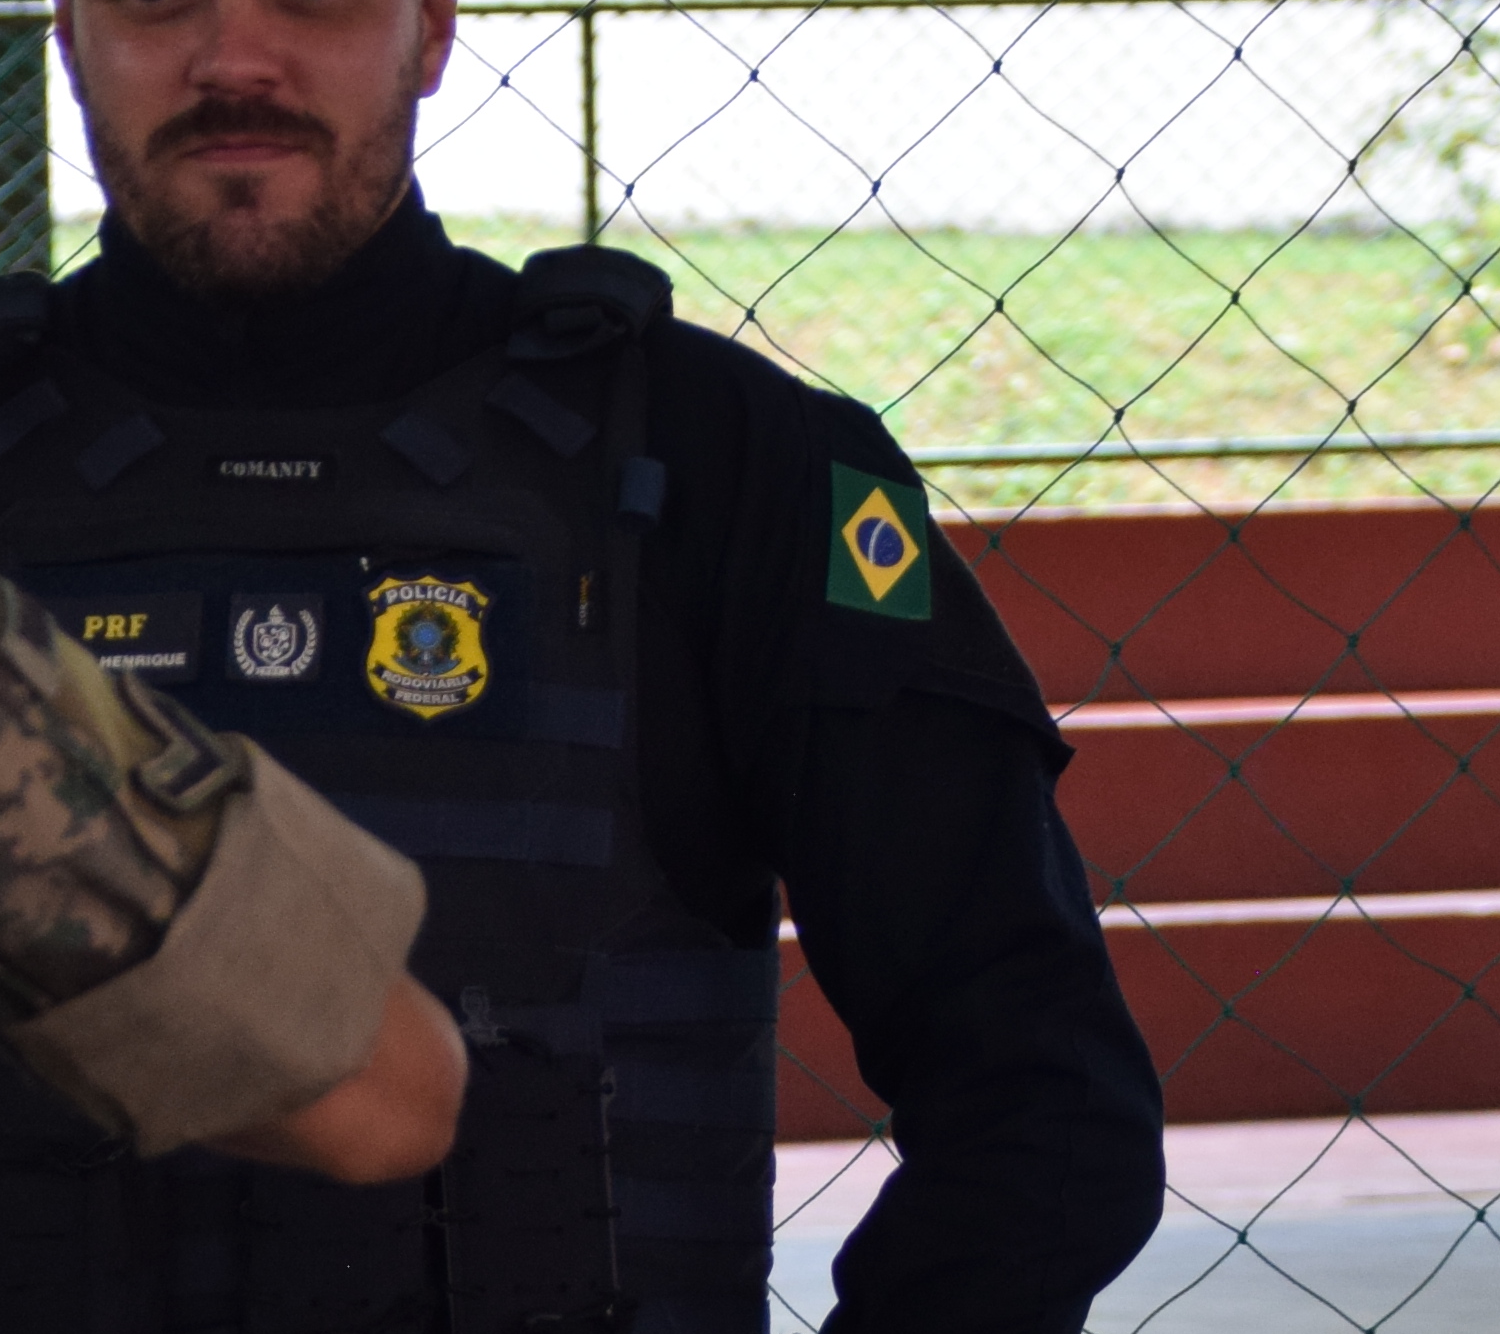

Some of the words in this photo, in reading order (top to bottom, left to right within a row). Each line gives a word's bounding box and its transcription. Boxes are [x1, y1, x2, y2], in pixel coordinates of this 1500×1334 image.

[83, 614, 148, 640] PRF
[100, 652, 187, 669] HENRIQUE
[393, 690, 460, 705] FEDERAL
